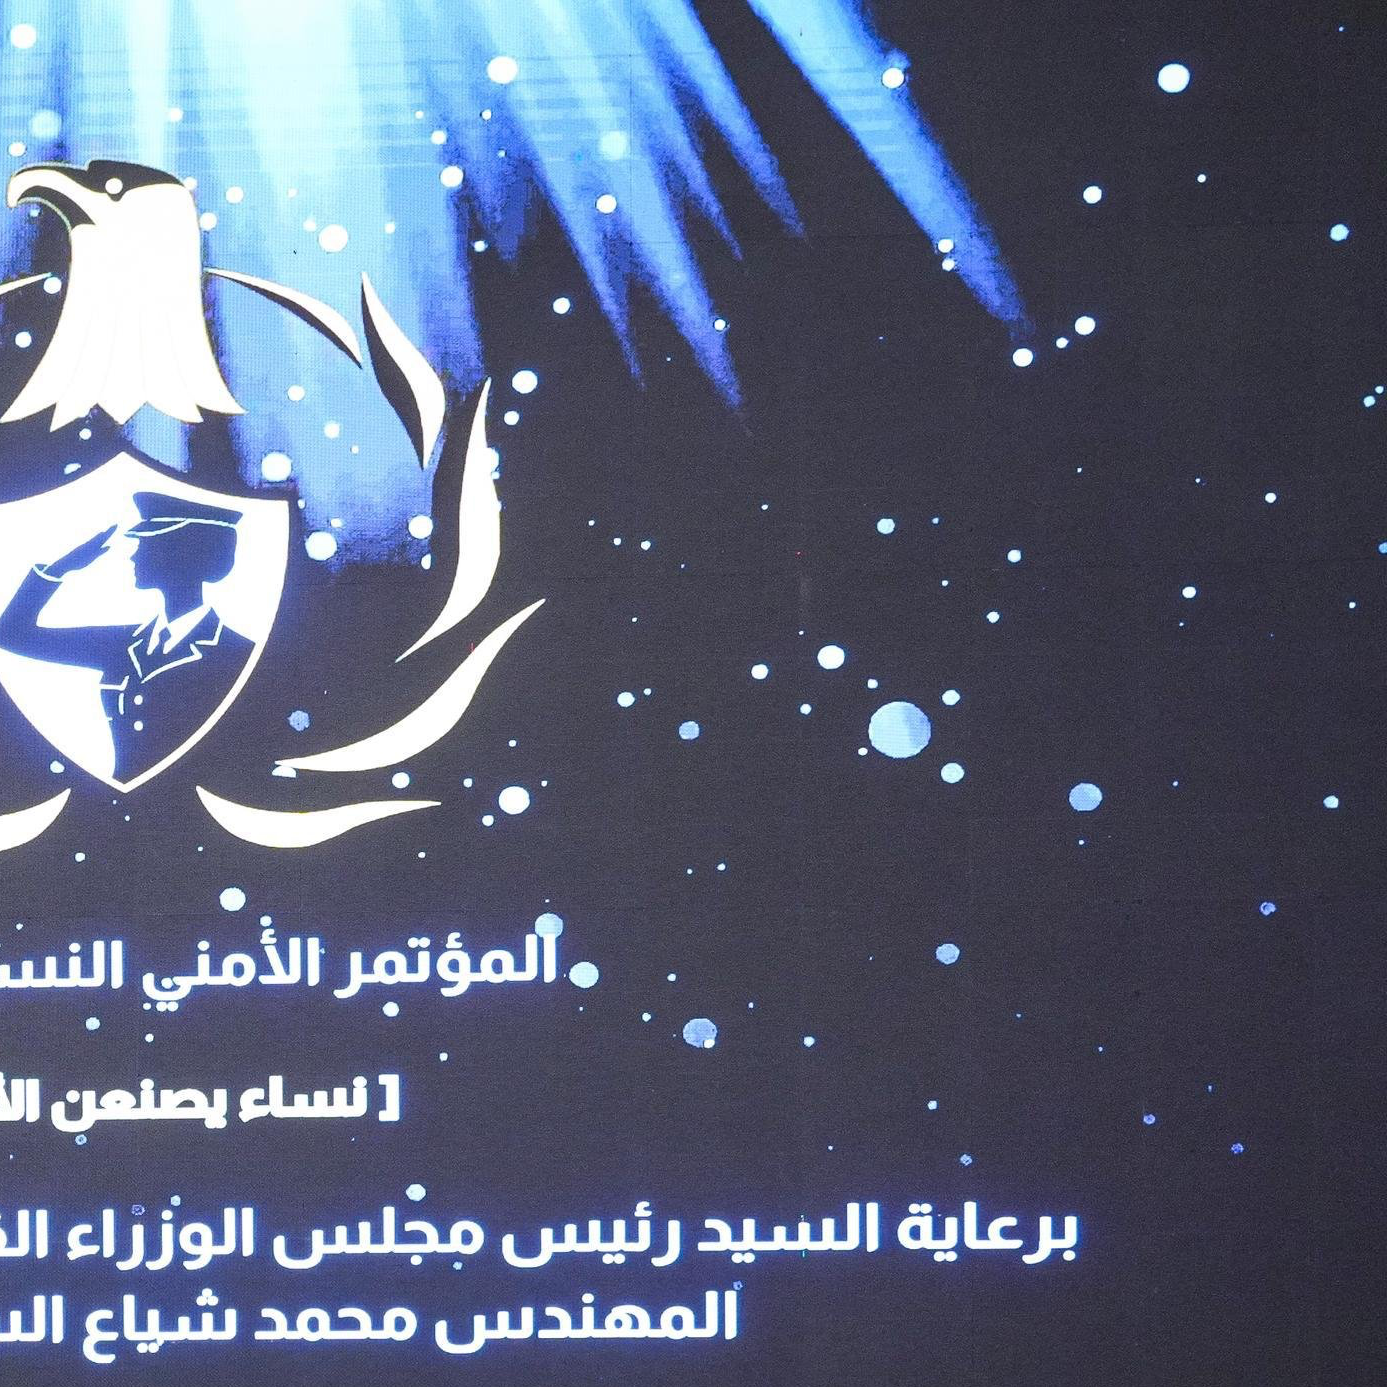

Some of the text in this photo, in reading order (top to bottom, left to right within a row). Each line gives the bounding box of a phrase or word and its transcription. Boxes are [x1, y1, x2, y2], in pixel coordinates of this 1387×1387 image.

[141, 927, 321, 1013] الأمني
[332, 931, 558, 1000] المؤتمر
[50, 1077, 228, 1134] يصنعن
[66, 1206, 255, 1272] الوزراء
[272, 1205, 486, 1270] مجلس
[501, 1200, 682, 1269] رئيس
[696, 1201, 880, 1265] السيد
[896, 1200, 1079, 1266] برعاية
[82, 1287, 238, 1365] شياع
[253, 1305, 419, 1343] محمد
[433, 1289, 739, 1356] المهندس
